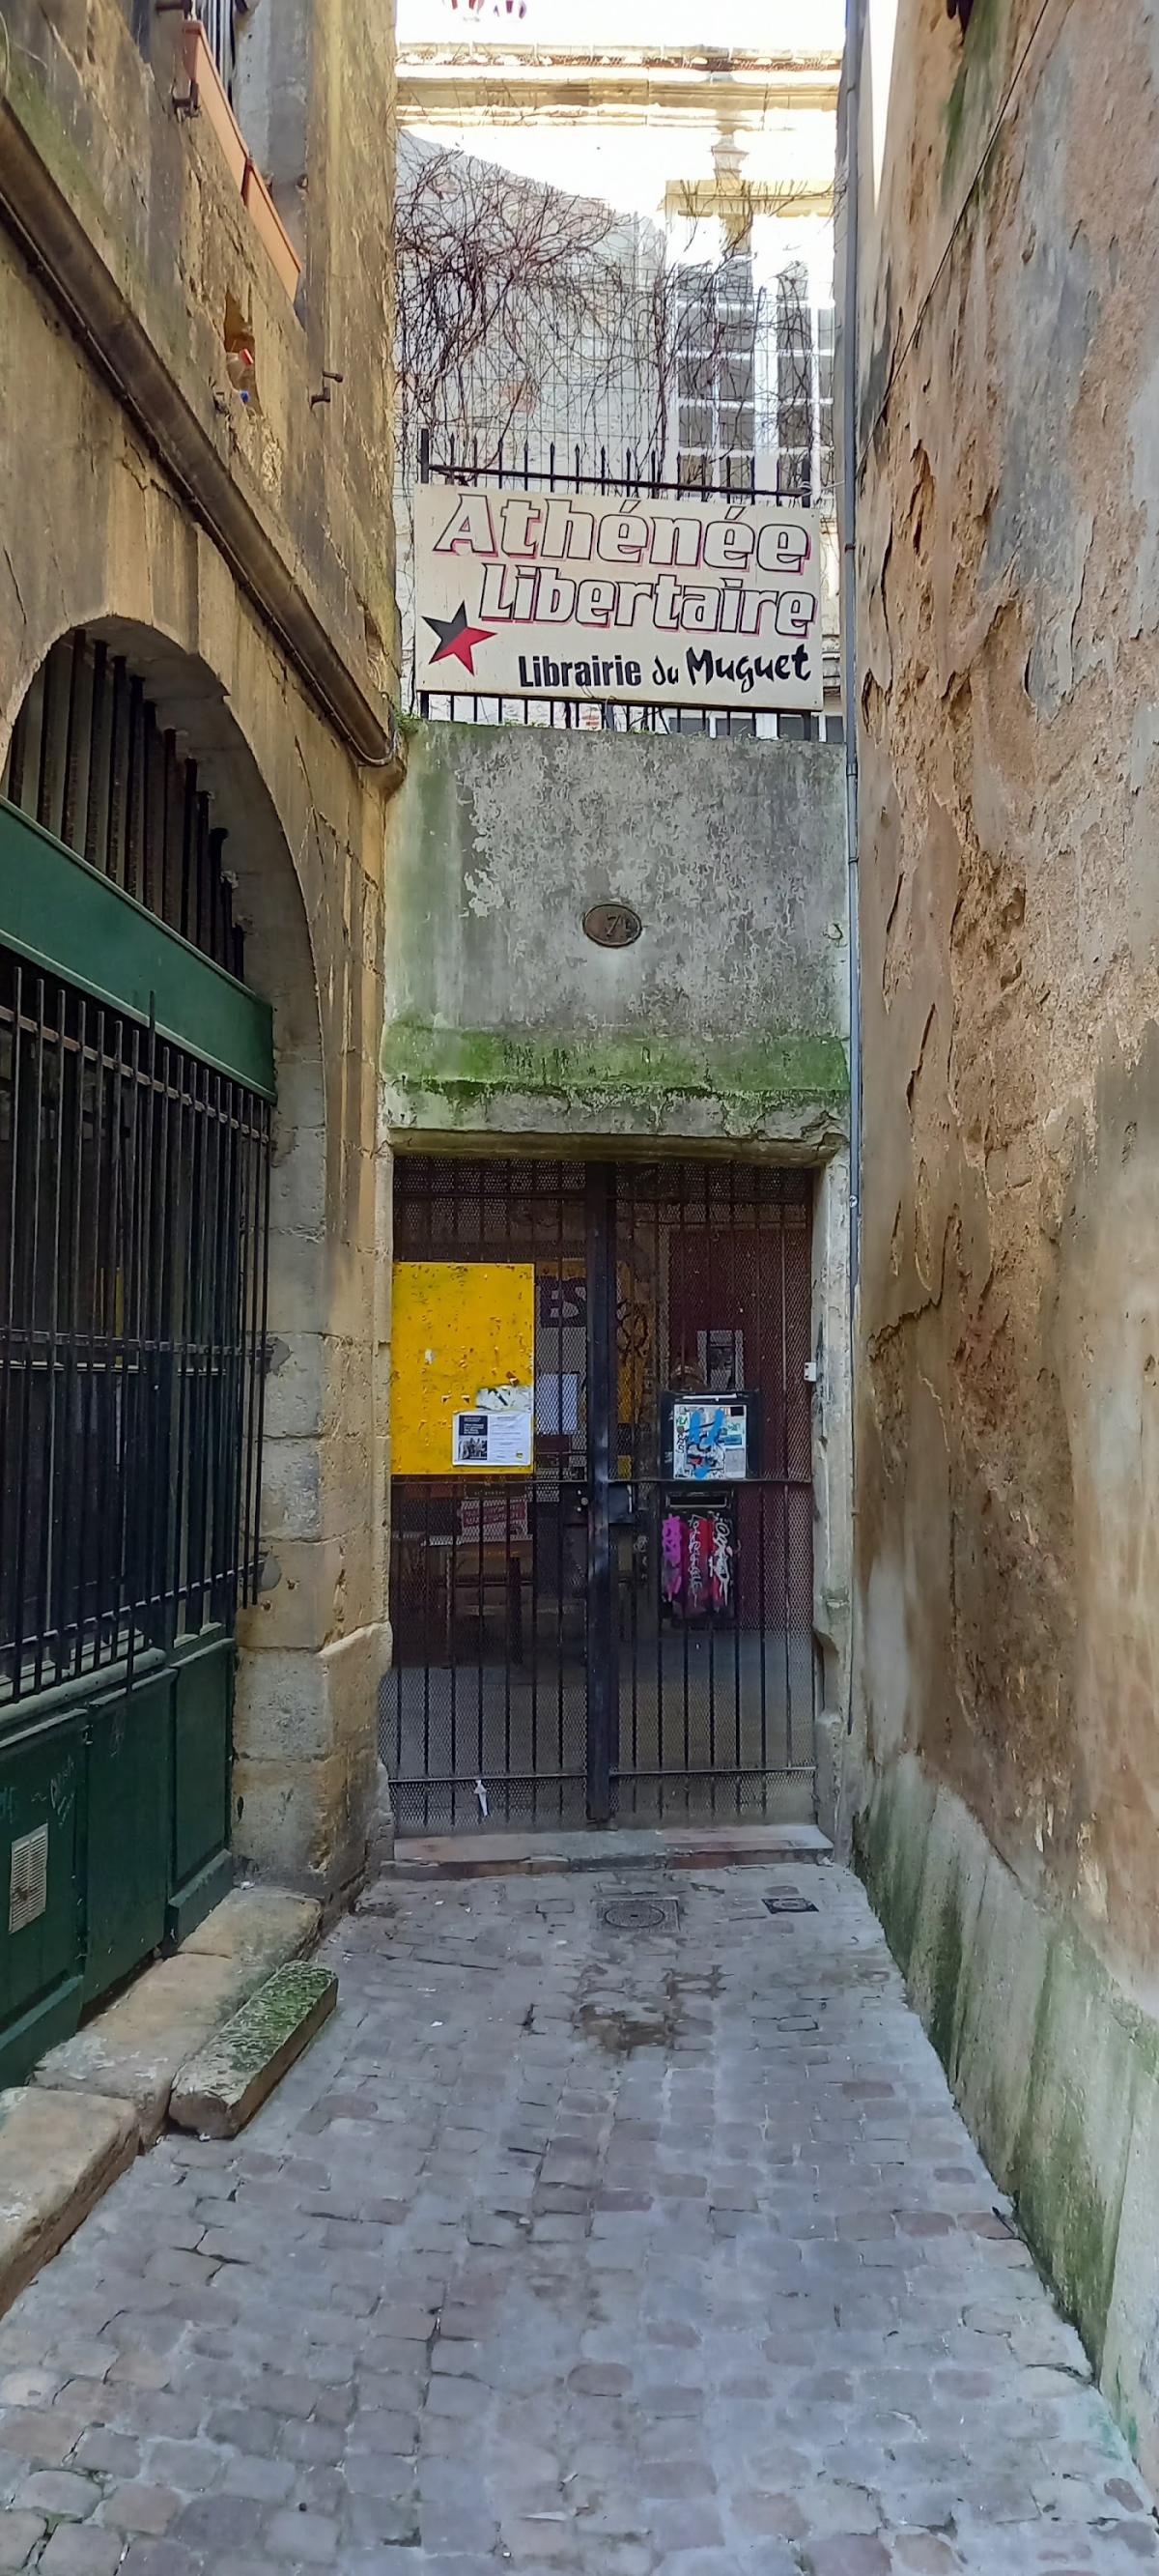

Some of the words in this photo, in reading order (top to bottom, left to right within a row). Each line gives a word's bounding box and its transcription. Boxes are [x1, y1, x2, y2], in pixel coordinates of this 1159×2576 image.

[433, 493, 812, 575] Athénée
[479, 562, 819, 639] Libertaire
[518, 655, 642, 688] Librairie
[652, 655, 679, 685] du
[685, 643, 811, 694] Muguet
